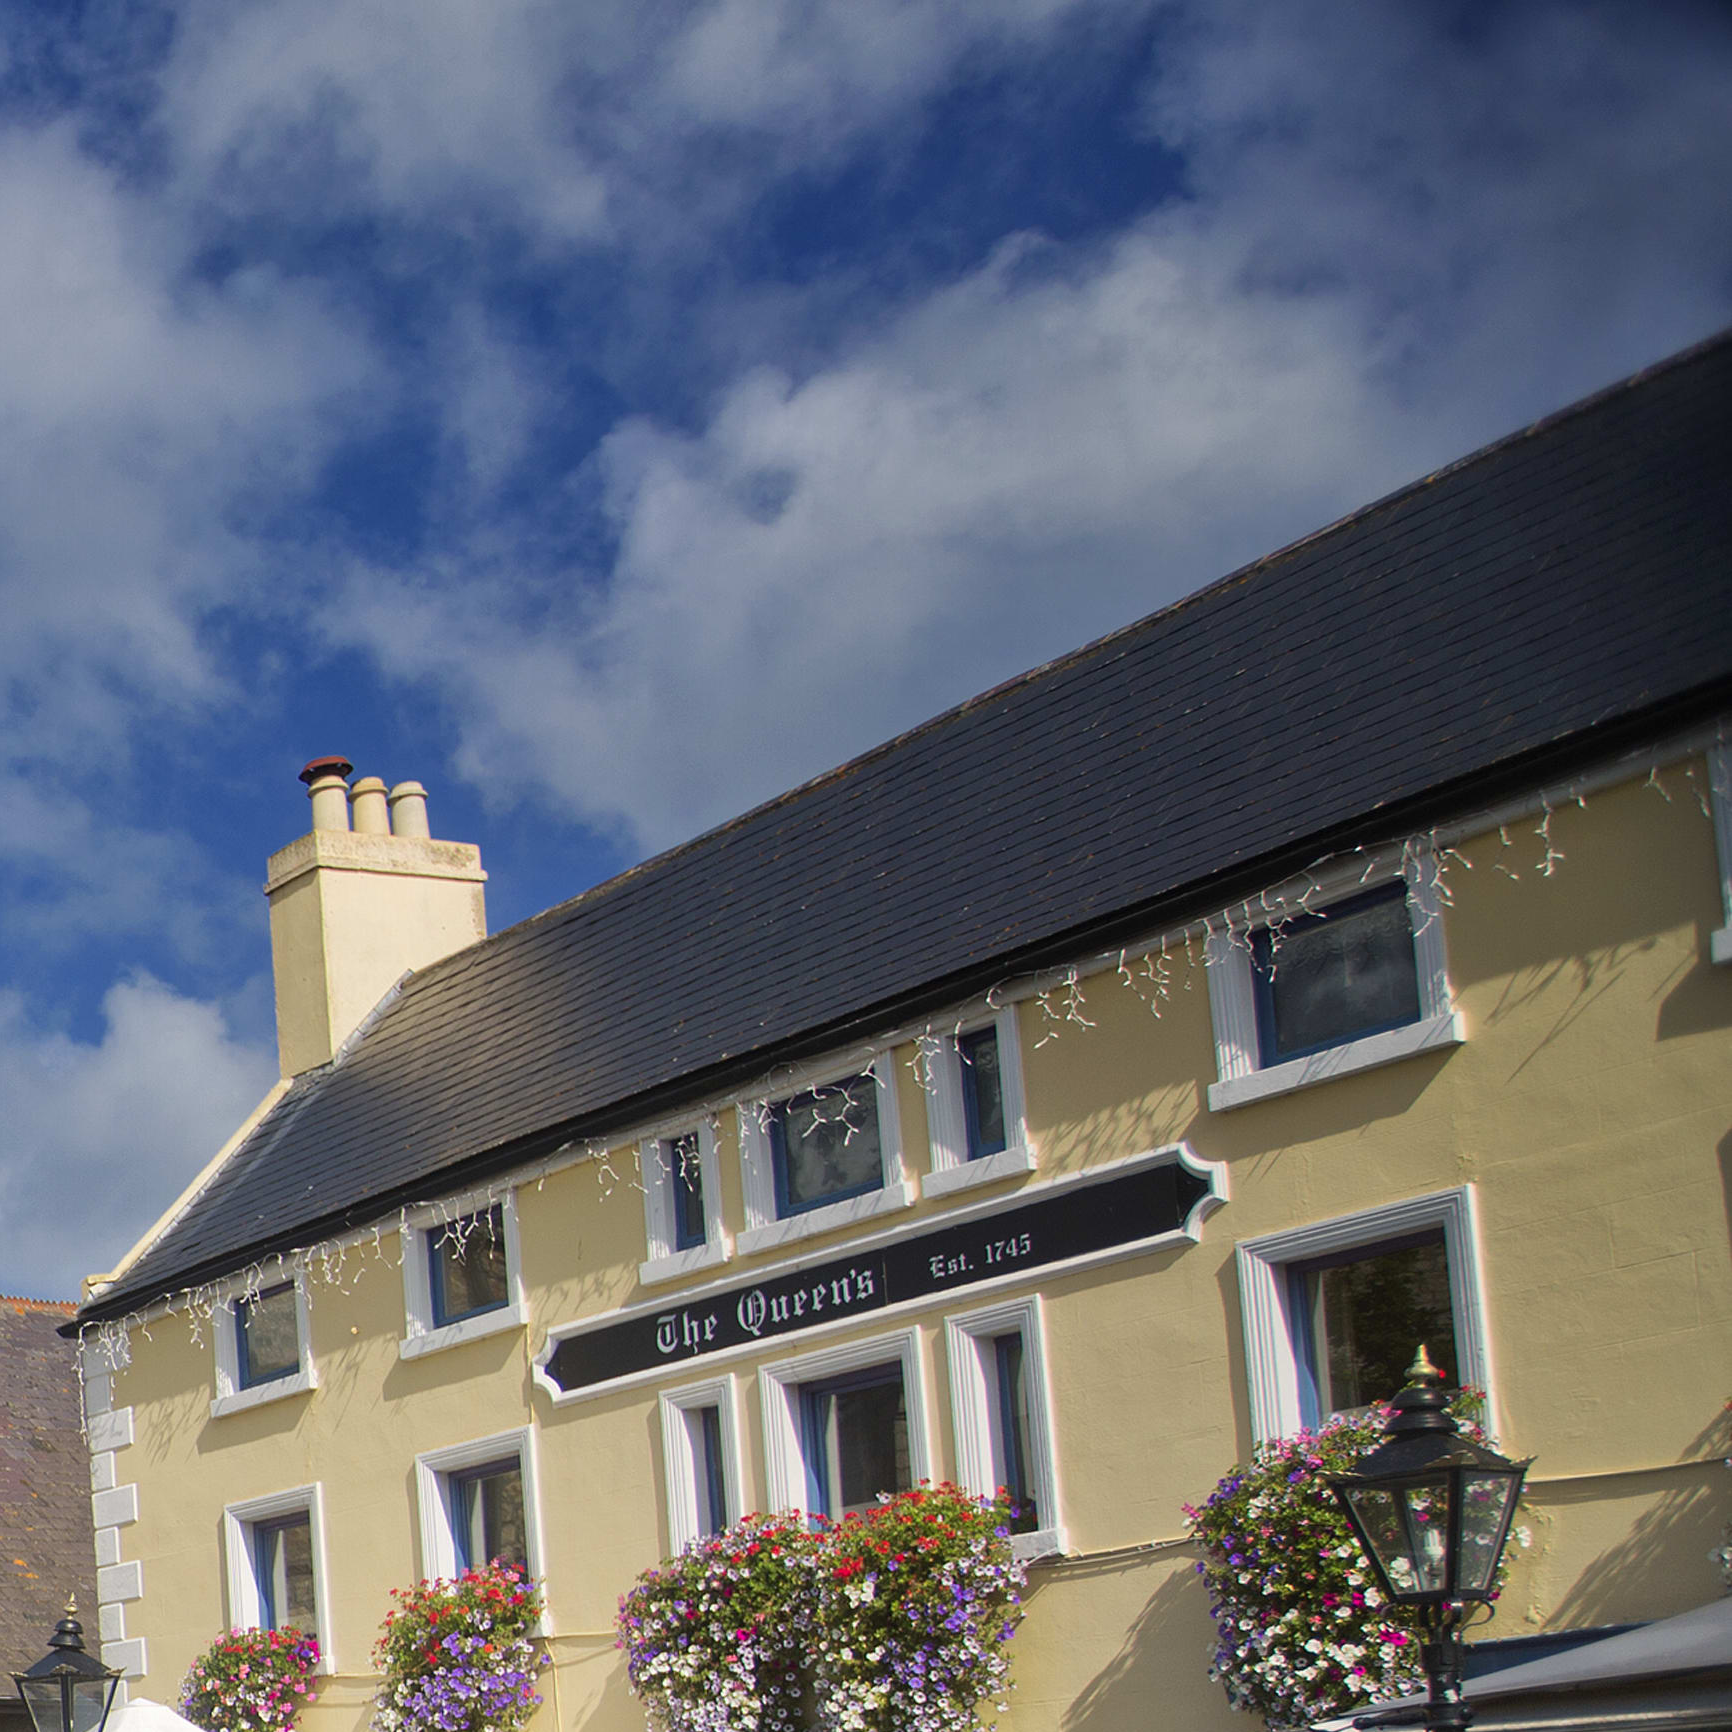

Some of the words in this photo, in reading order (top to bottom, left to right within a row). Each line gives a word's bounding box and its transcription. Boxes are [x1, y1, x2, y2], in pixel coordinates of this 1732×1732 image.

[929, 1253, 974, 1279] Est.
[985, 1233, 1031, 1263] 1745
[656, 1311, 717, 1354] The
[737, 1268, 875, 1336] Queen's
